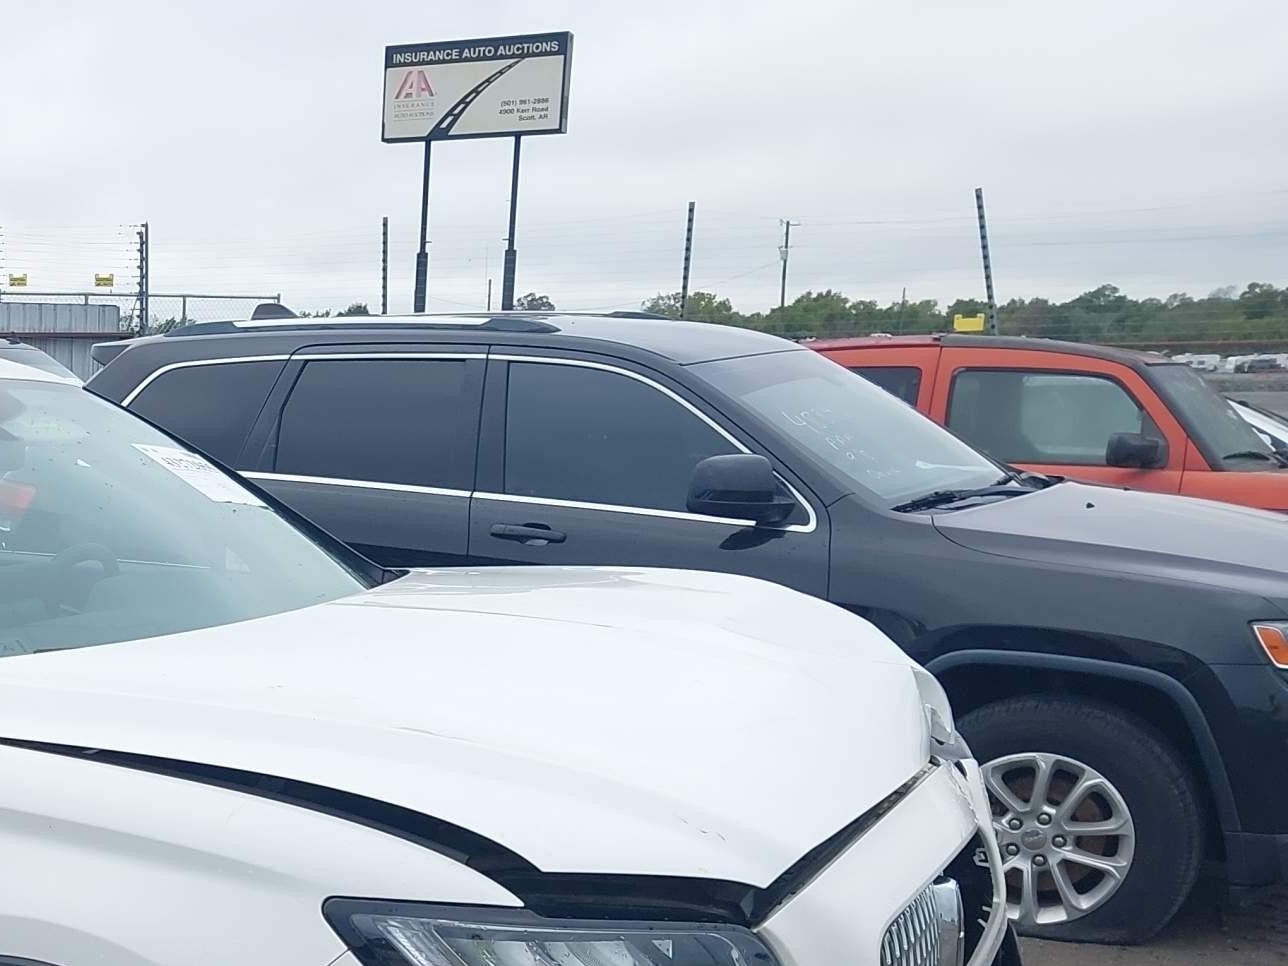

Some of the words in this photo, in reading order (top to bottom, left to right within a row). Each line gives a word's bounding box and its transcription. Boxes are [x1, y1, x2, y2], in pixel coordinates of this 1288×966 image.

[392, 49, 460, 64] INSURANCE
[462, 46, 495, 59] AUTO
[497, 40, 560, 56] AUCTIONS
